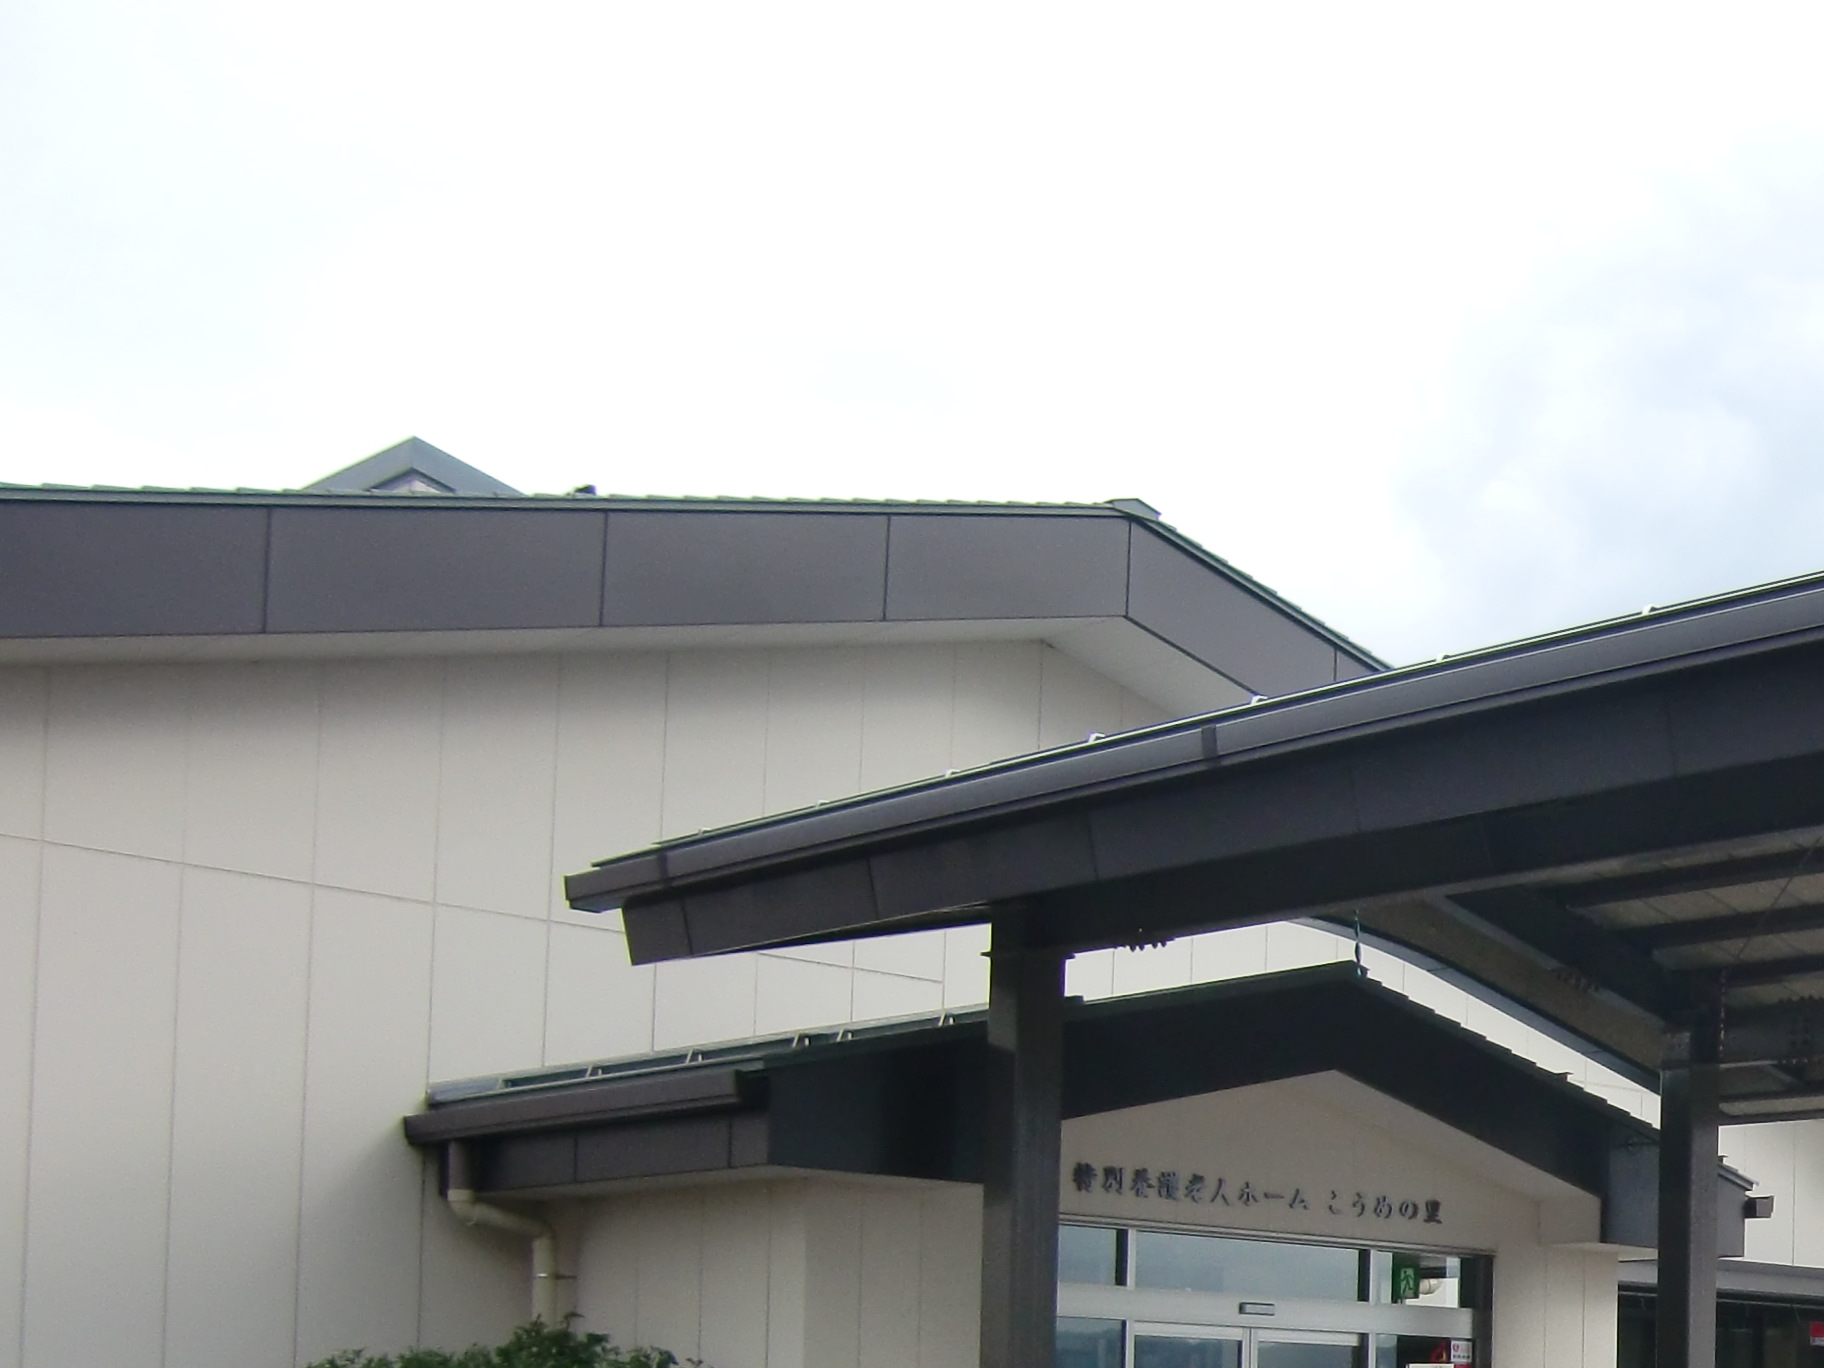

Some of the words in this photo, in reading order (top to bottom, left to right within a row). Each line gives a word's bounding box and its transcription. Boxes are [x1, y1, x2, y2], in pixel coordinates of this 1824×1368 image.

[1072, 1161, 1311, 1211] 特別養護老人ホーム
[1329, 1189, 1443, 1225] こうめの里
